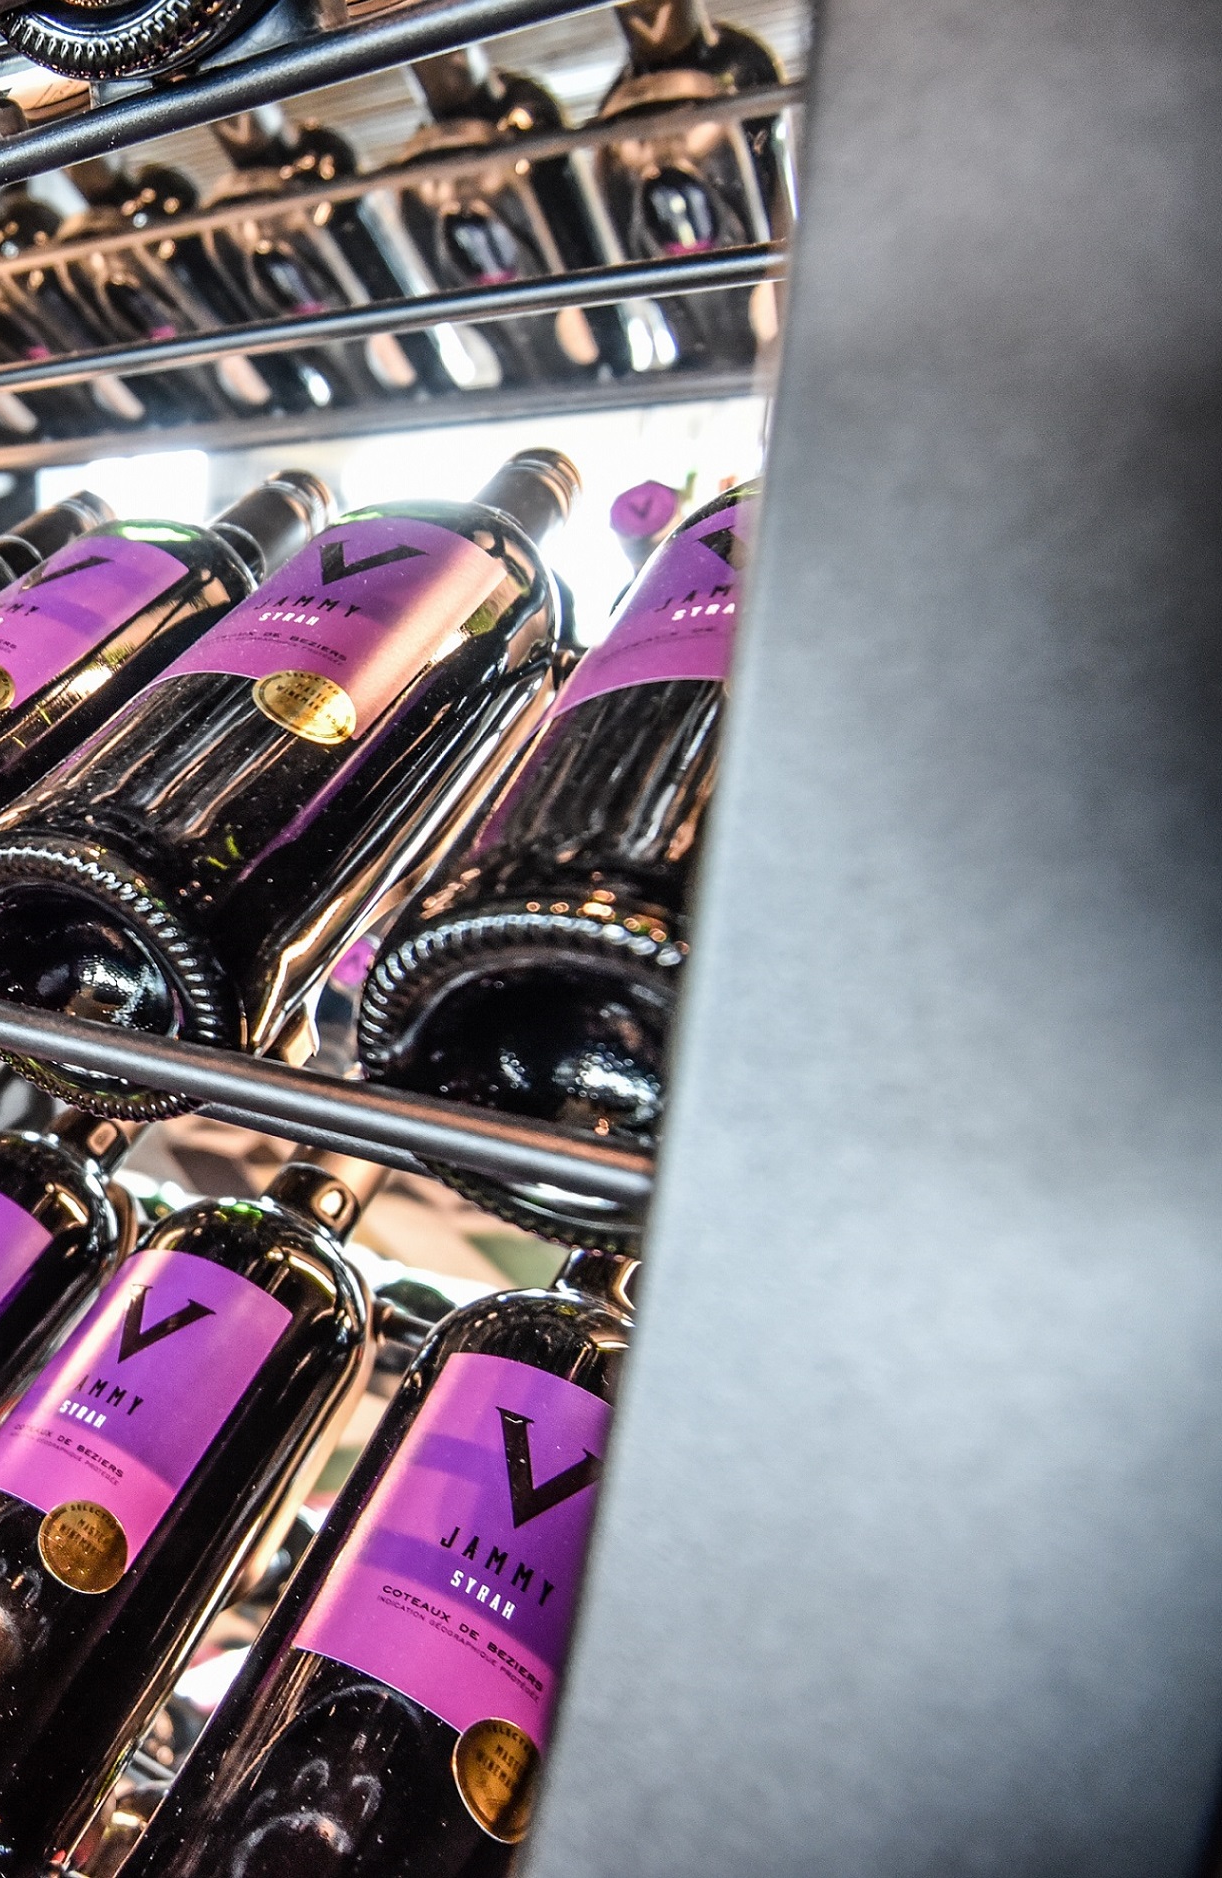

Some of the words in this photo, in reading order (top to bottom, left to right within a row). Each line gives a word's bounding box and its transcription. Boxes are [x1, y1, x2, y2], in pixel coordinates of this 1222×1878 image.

[319, 539, 430, 586] V
[254, 595, 361, 618] JAMMY
[655, 583, 734, 612] JAM
[672, 602, 735, 621] SYRA
[258, 612, 320, 626] SYRAH
[289, 635, 348, 662] BEZIERS
[117, 1283, 217, 1364] V
[59, 1399, 107, 1429] SYRAH
[74, 1374, 144, 1416] AMMY
[57, 1435, 73, 1446] DE
[76, 1444, 124, 1478] BEZIERS
[496, 1406, 605, 1529] V
[440, 1526, 555, 1607] JAMMY
[450, 1568, 516, 1620] SYRAH
[382, 1585, 451, 1623] COTEAUX
[458, 1623, 480, 1641] DE
[486, 1641, 544, 1692] BEZIERS
